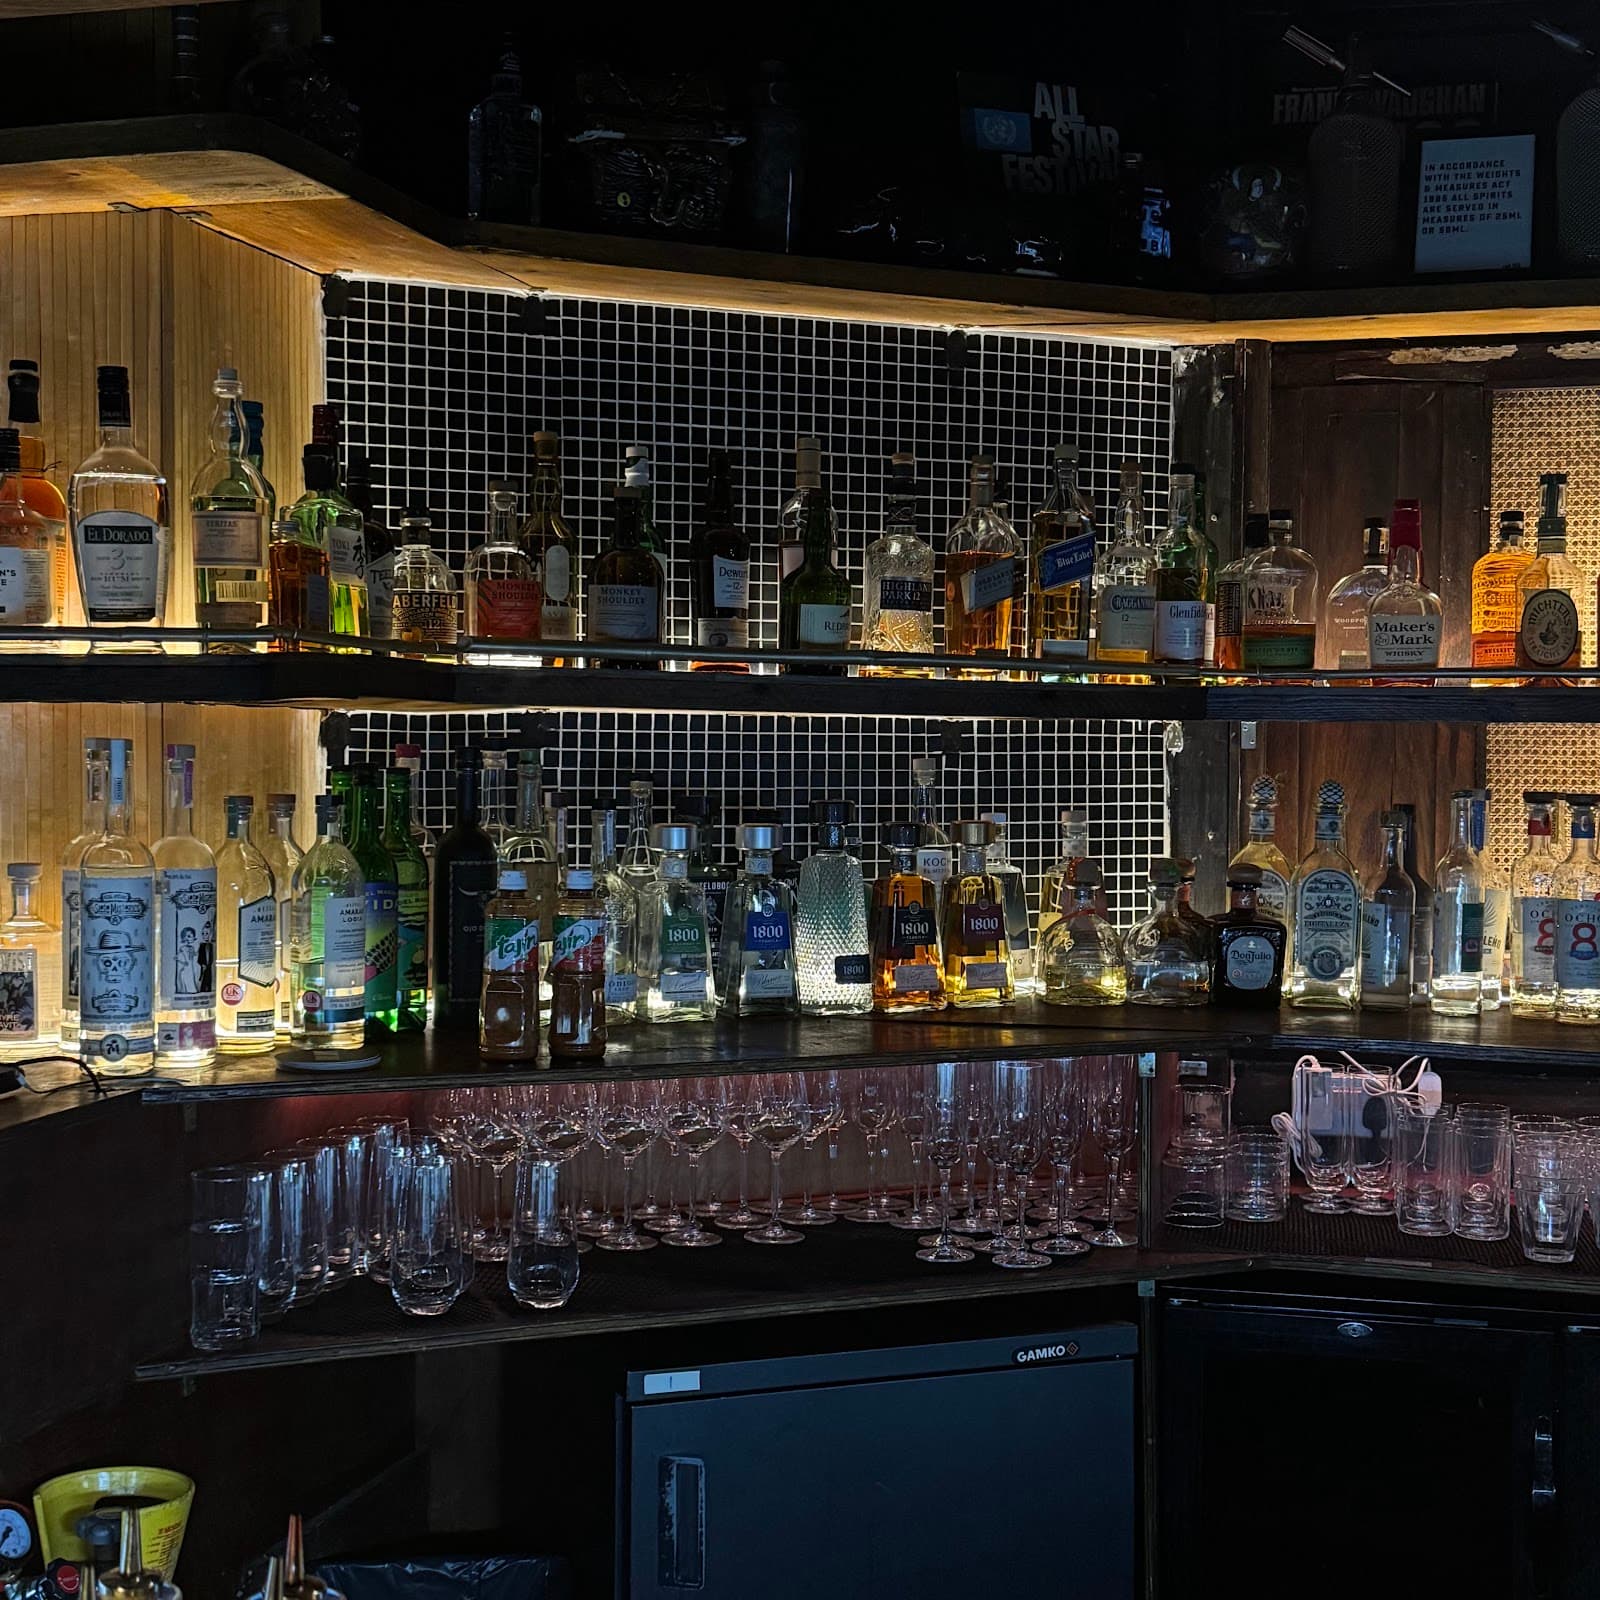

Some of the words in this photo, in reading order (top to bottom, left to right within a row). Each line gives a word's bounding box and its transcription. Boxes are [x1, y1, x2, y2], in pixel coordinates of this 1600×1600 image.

[1034, 82, 1078, 119] ALL
[1051, 115, 1120, 161] STAR
[1440, 160, 1505, 170] ACCORDANCE
[1424, 174, 1450, 182] WITH
[1455, 172, 1472, 180] THE
[1476, 169, 1520, 179] WEIGHTS
[1435, 182, 1487, 192] MEASURES
[1451, 193, 1469, 201] ALL
[1473, 191, 1512, 200] SPIRITS
[1423, 205, 1441, 214] ARE
[1446, 203, 1484, 212] SERVED
[1488, 202, 1498, 210] IN
[1422, 214, 1475, 224] MEASURES
[1479, 213, 1493, 221] OF
[1495, 212, 1522, 220] 25ML
[88, 528, 102, 542] EL
[103, 528, 150, 542] DORADO
[112, 548, 126, 570] 3
[1056, 556, 1073, 568] Blue
[1074, 549, 1093, 562] Label
[600, 587, 641, 596] MONKEY
[882, 591, 911, 600] PARK
[913, 591, 921, 601] 12
[1374, 622, 1435, 633] Maker's
[1390, 634, 1434, 645] Mark
[1565, 912, 1600, 923] OCH
[900, 922, 929, 935] 1800
[970, 917, 998, 931] 1800
[667, 928, 699, 942] 1800
[753, 925, 783, 939] 1800
[1483, 935, 1502, 949] LEÑO
[1230, 950, 1250, 962] Don
[1250, 950, 1271, 962] Julio
[843, 965, 864, 975] 1800
[1017, 1345, 1066, 1363] GAMKO
